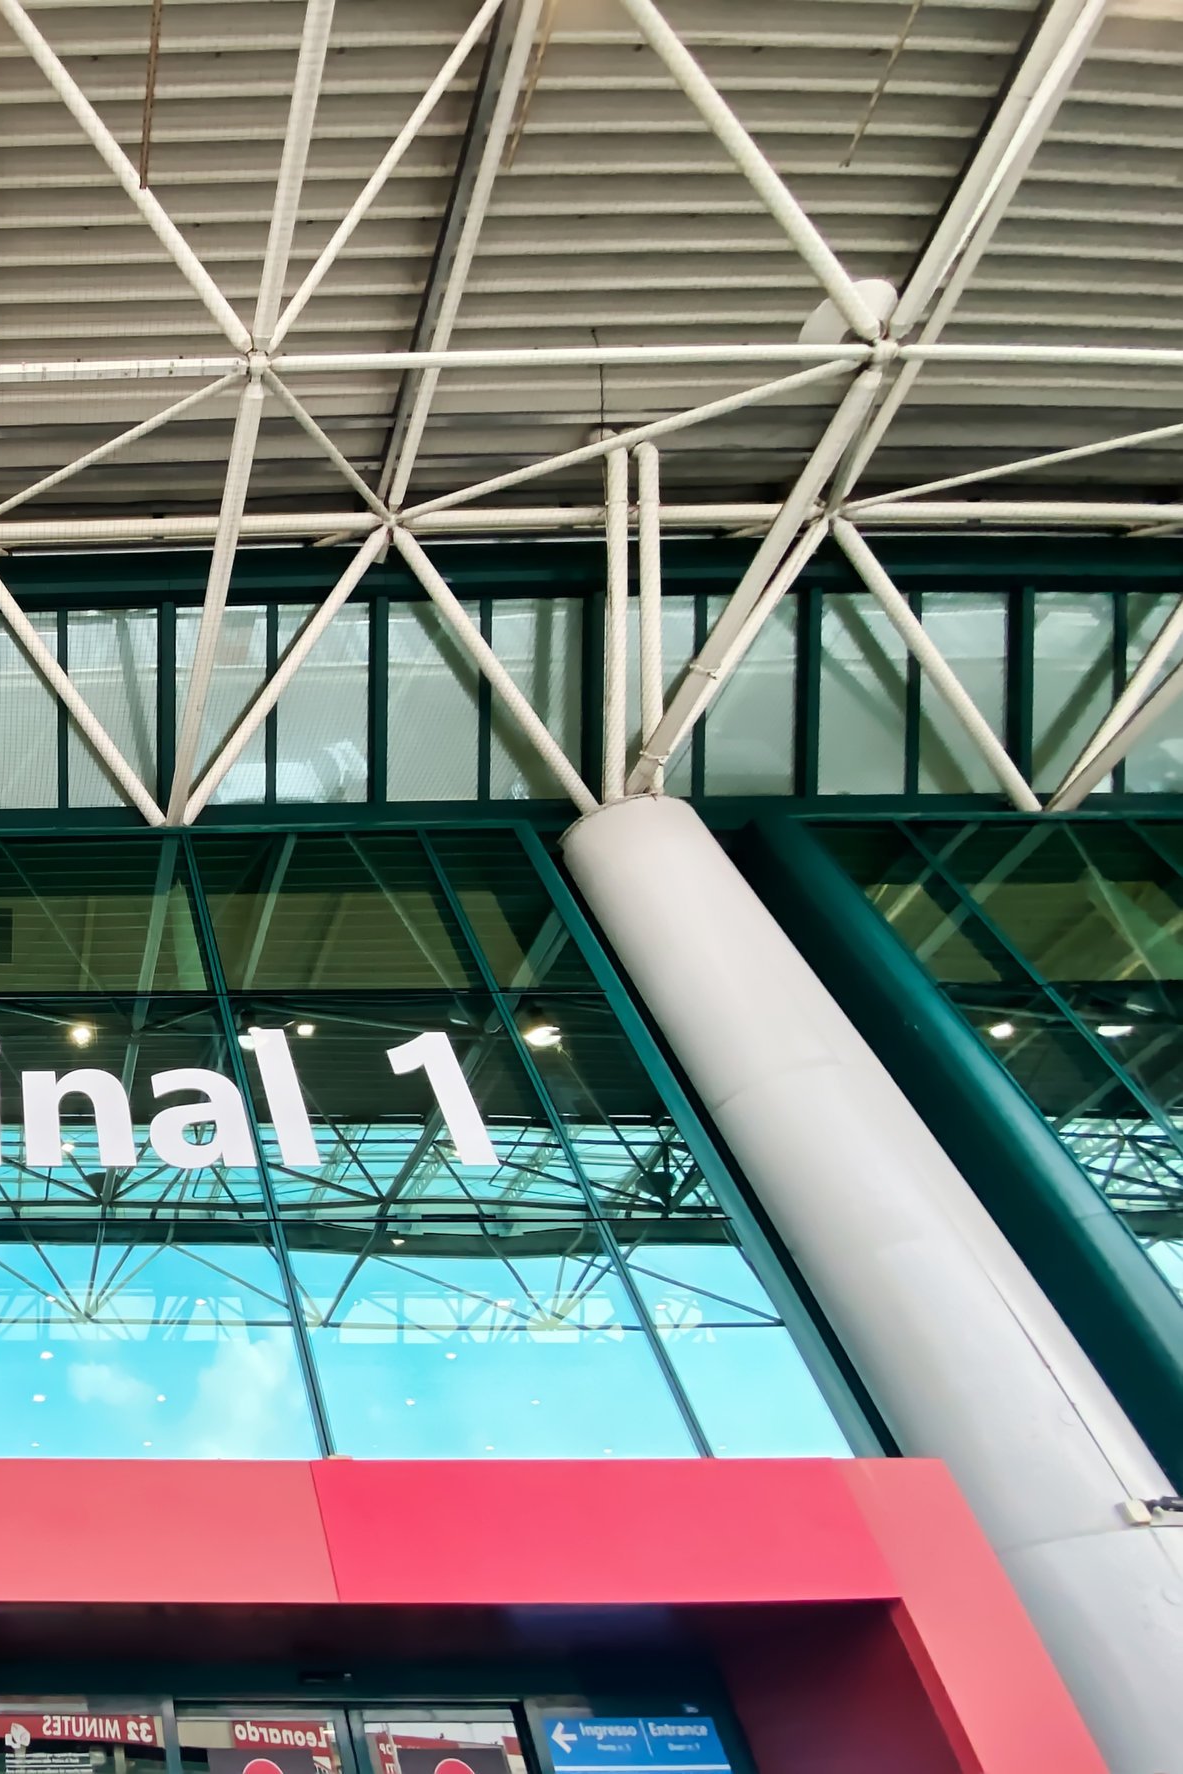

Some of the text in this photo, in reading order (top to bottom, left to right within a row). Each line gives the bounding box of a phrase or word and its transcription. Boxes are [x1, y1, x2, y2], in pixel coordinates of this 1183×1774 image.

[386, 1031, 500, 1166] 1
[579, 1721, 637, 1740] Ingresso
[648, 1721, 707, 1737] Entrance
